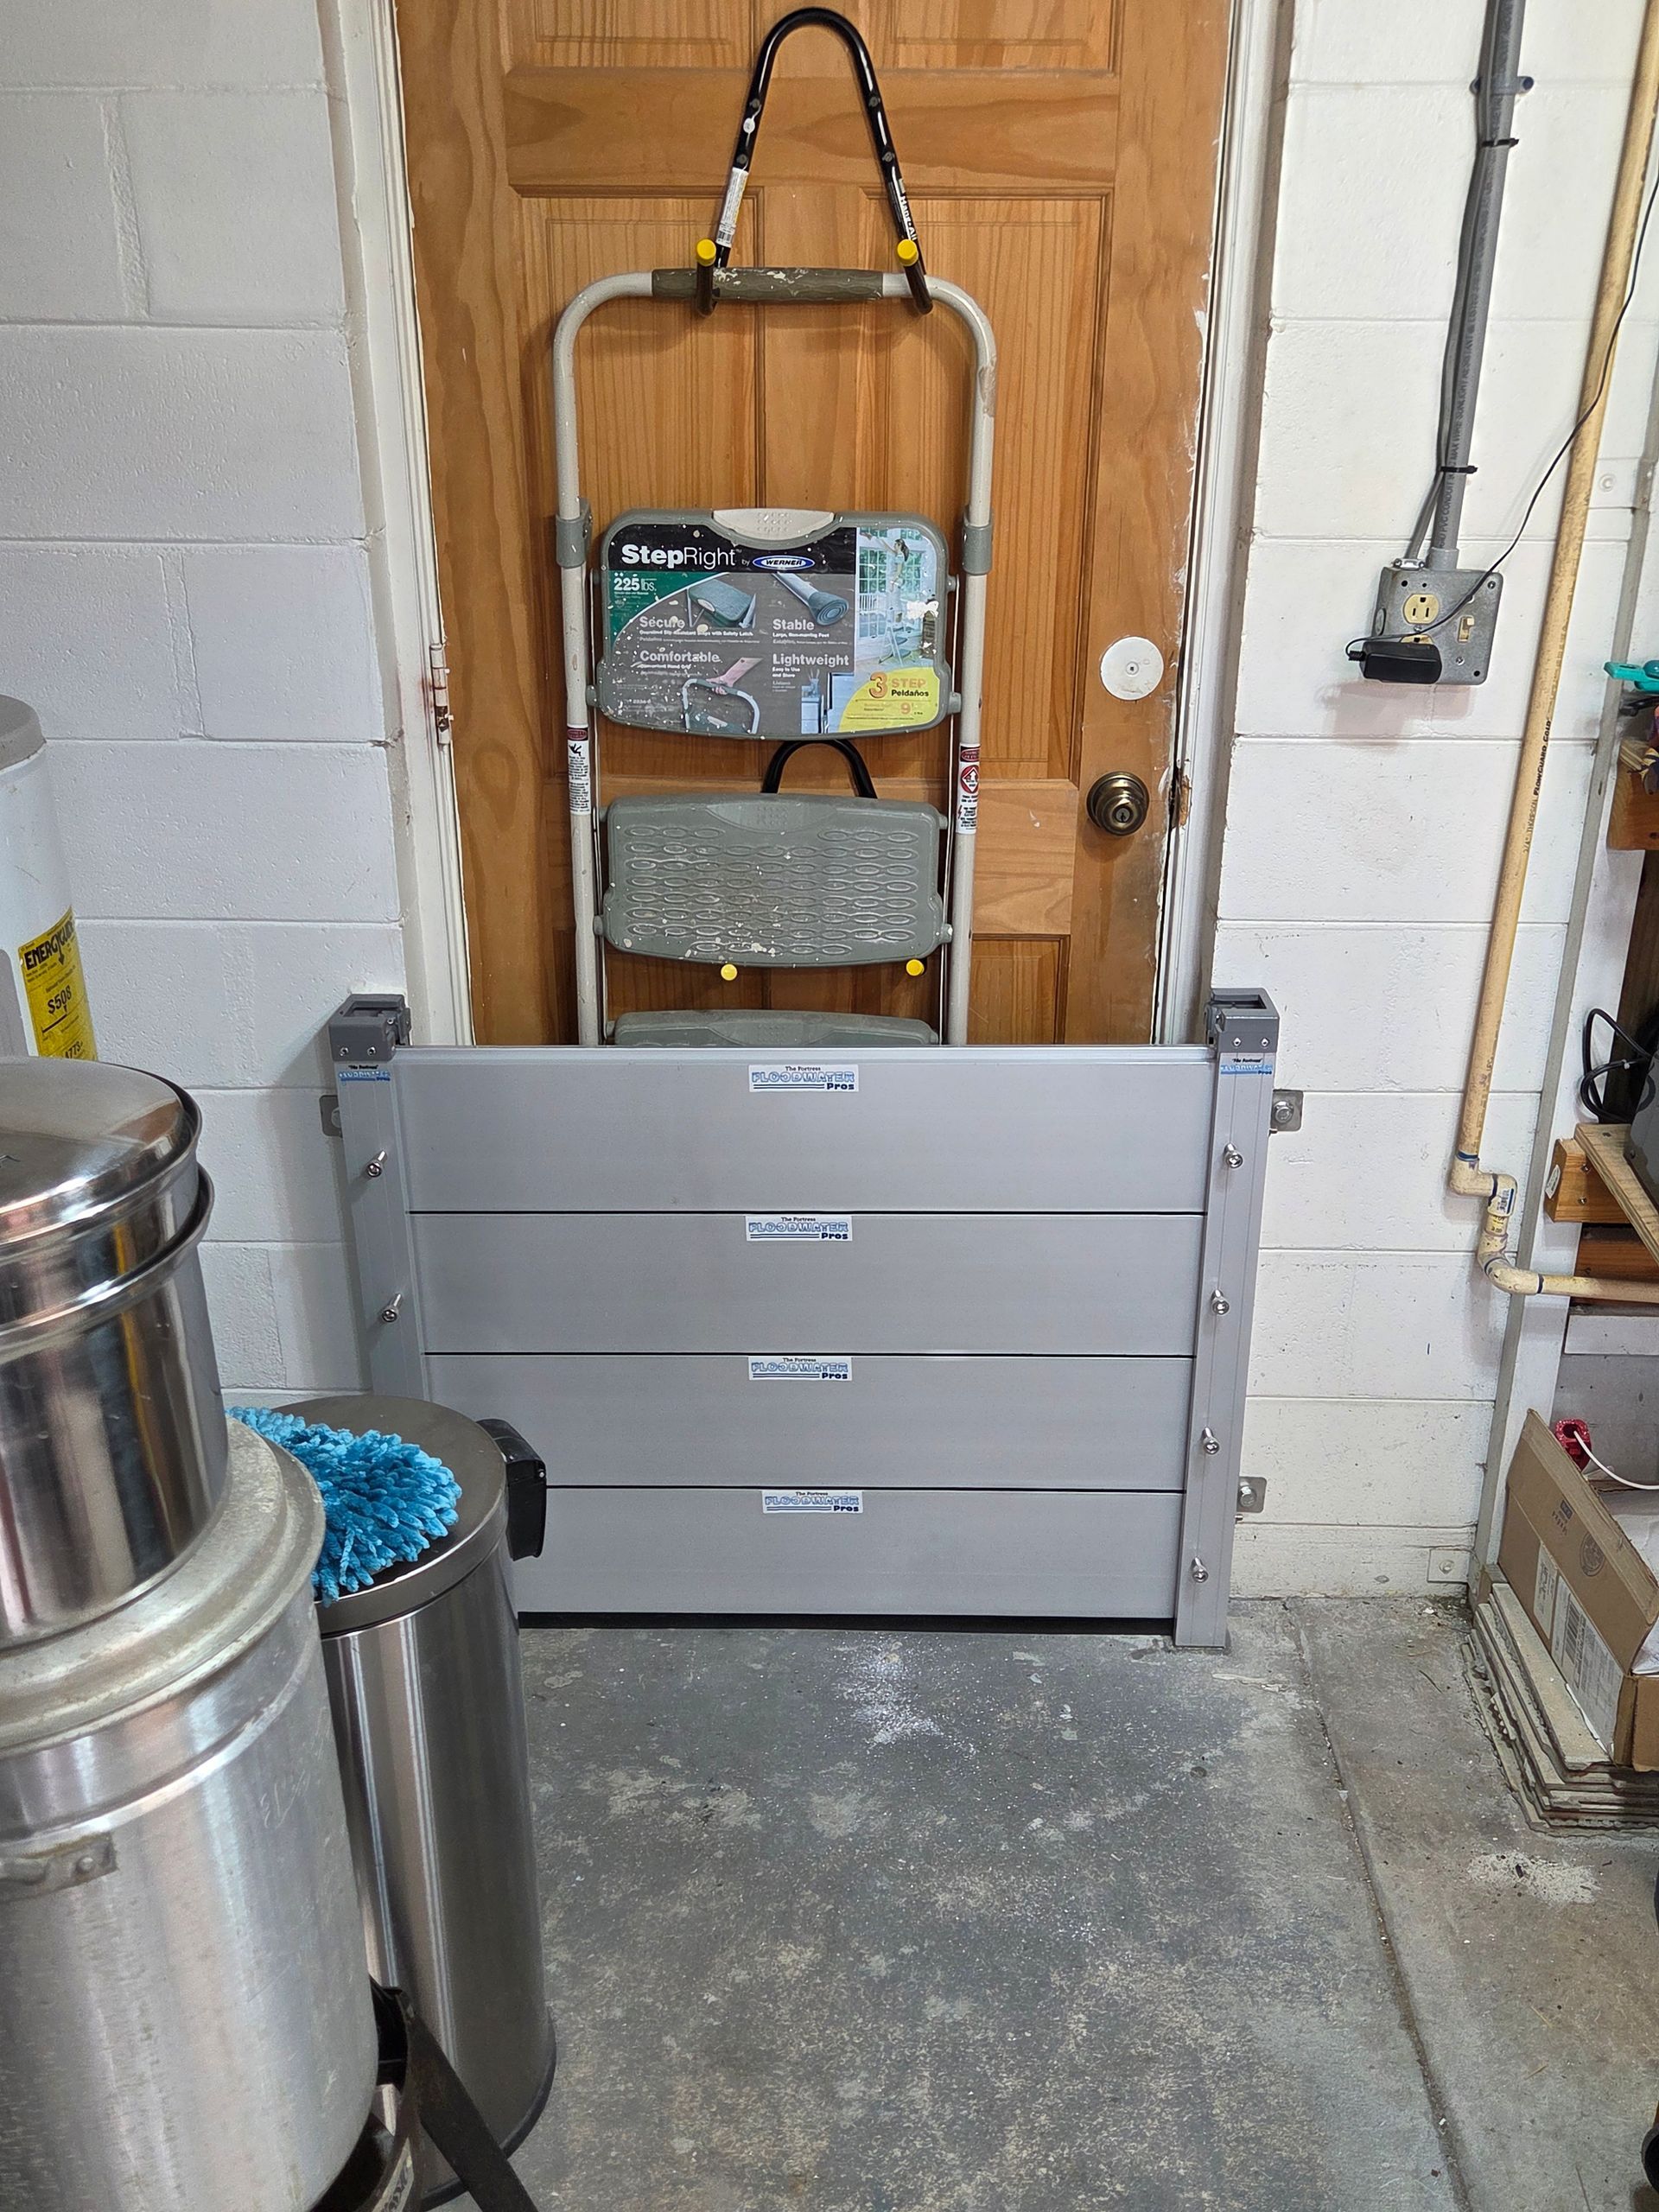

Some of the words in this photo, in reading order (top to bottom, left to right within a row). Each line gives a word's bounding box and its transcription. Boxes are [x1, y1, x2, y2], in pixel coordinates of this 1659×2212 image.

[1438, 516, 1448, 532] PVC
[613, 576, 640, 591] 225
[772, 618, 815, 630] Stable
[772, 653, 849, 668] Lightweight
[868, 671, 887, 699] 3
[892, 677, 926, 689] STEP
[751, 1071, 855, 1083] FLOODWATER
[748, 1222, 849, 1232] FLOODWATER
[751, 1362, 849, 1373] FLOODWATER
[765, 1496, 860, 1505] FLOODWATER
